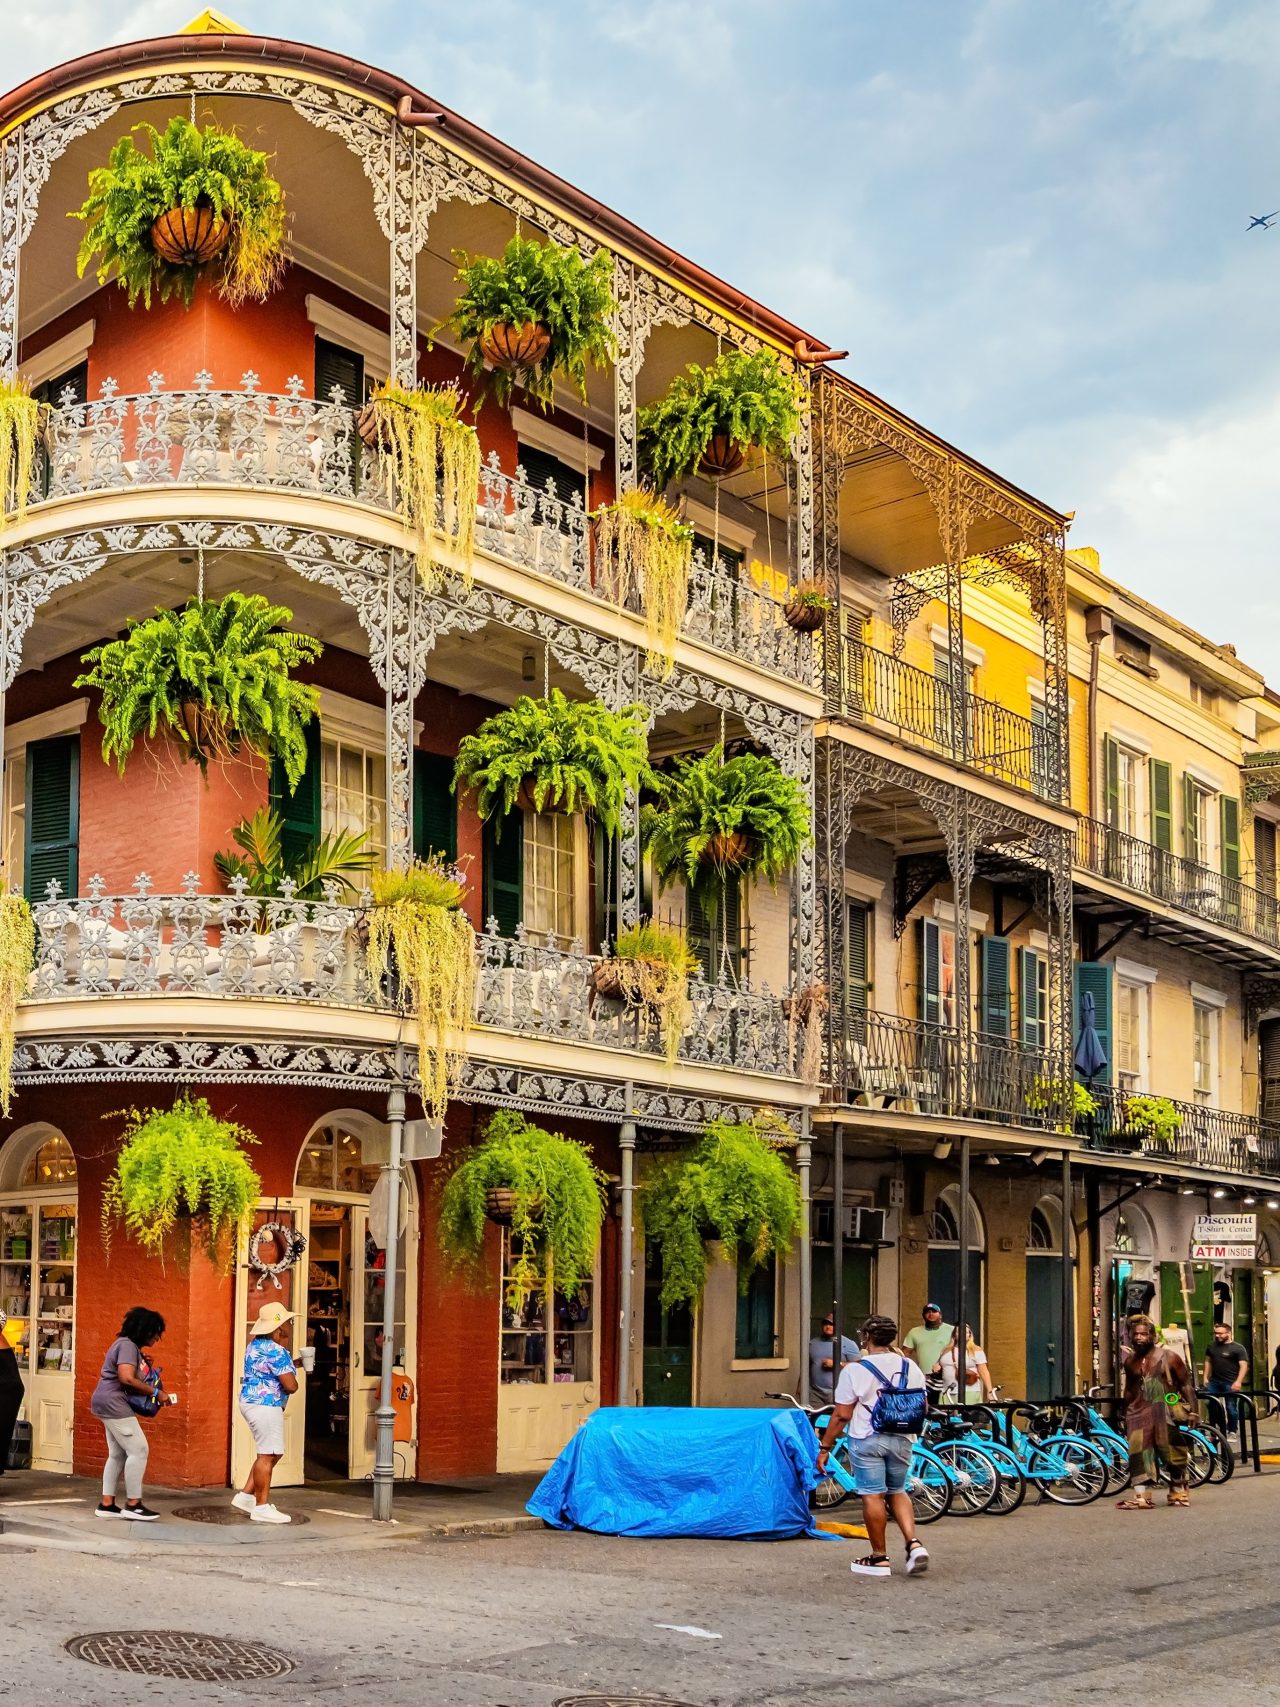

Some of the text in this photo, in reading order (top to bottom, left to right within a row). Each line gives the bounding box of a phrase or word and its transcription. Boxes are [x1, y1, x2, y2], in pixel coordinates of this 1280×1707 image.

[1197, 1216, 1253, 1225] Discount
[1196, 1247, 1253, 1256] ATM INSIDE
